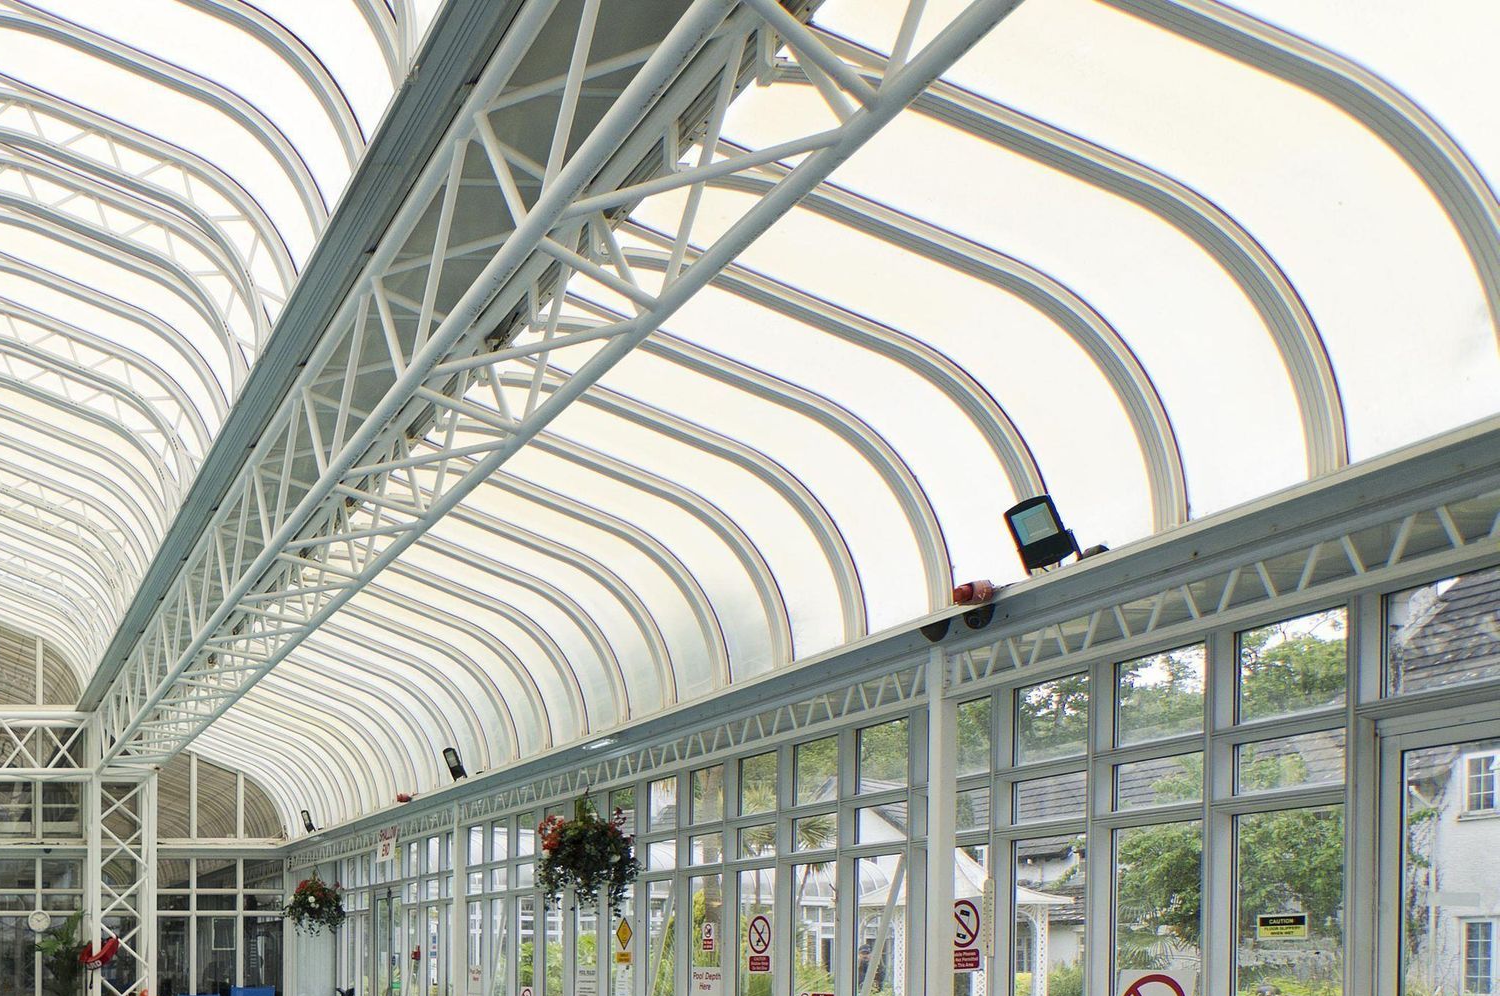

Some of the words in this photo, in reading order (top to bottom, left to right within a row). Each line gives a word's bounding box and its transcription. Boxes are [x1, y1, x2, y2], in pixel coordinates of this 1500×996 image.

[379, 826, 398, 842] SHALLOW
[382, 843, 390, 857] END
[693, 972, 704, 980] Pool
[705, 972, 722, 981] Depth
[698, 982, 711, 990] Here
